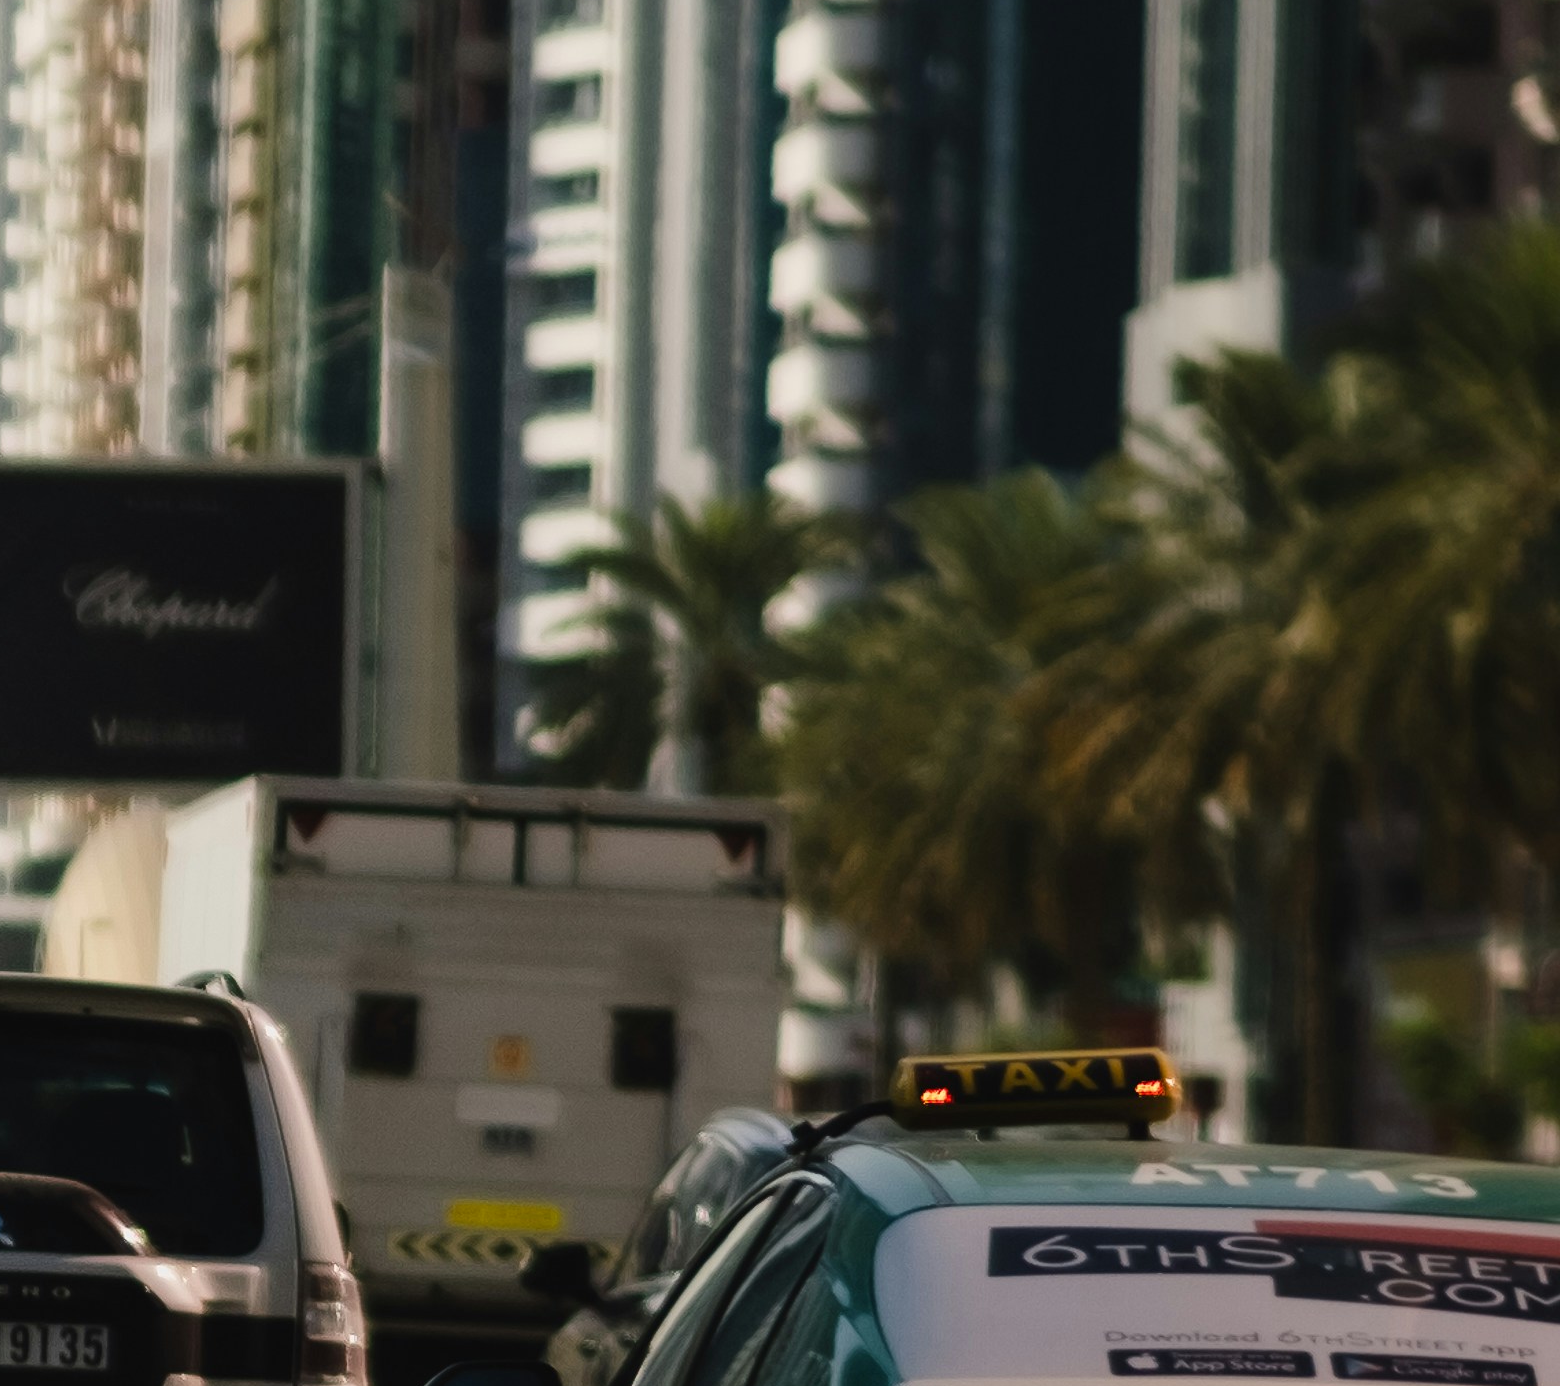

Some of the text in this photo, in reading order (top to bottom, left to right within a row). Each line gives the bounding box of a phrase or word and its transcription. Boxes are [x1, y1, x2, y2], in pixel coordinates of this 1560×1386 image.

[942, 1058, 1126, 1095] TAXI
[1130, 1162, 1477, 1199] AT713
[1023, 1235, 1560, 1285] 6THSREET
[1104, 1330, 1259, 1344] Download
[1479, 1344, 1536, 1358] app
[1173, 1359, 1296, 1372] App Store
